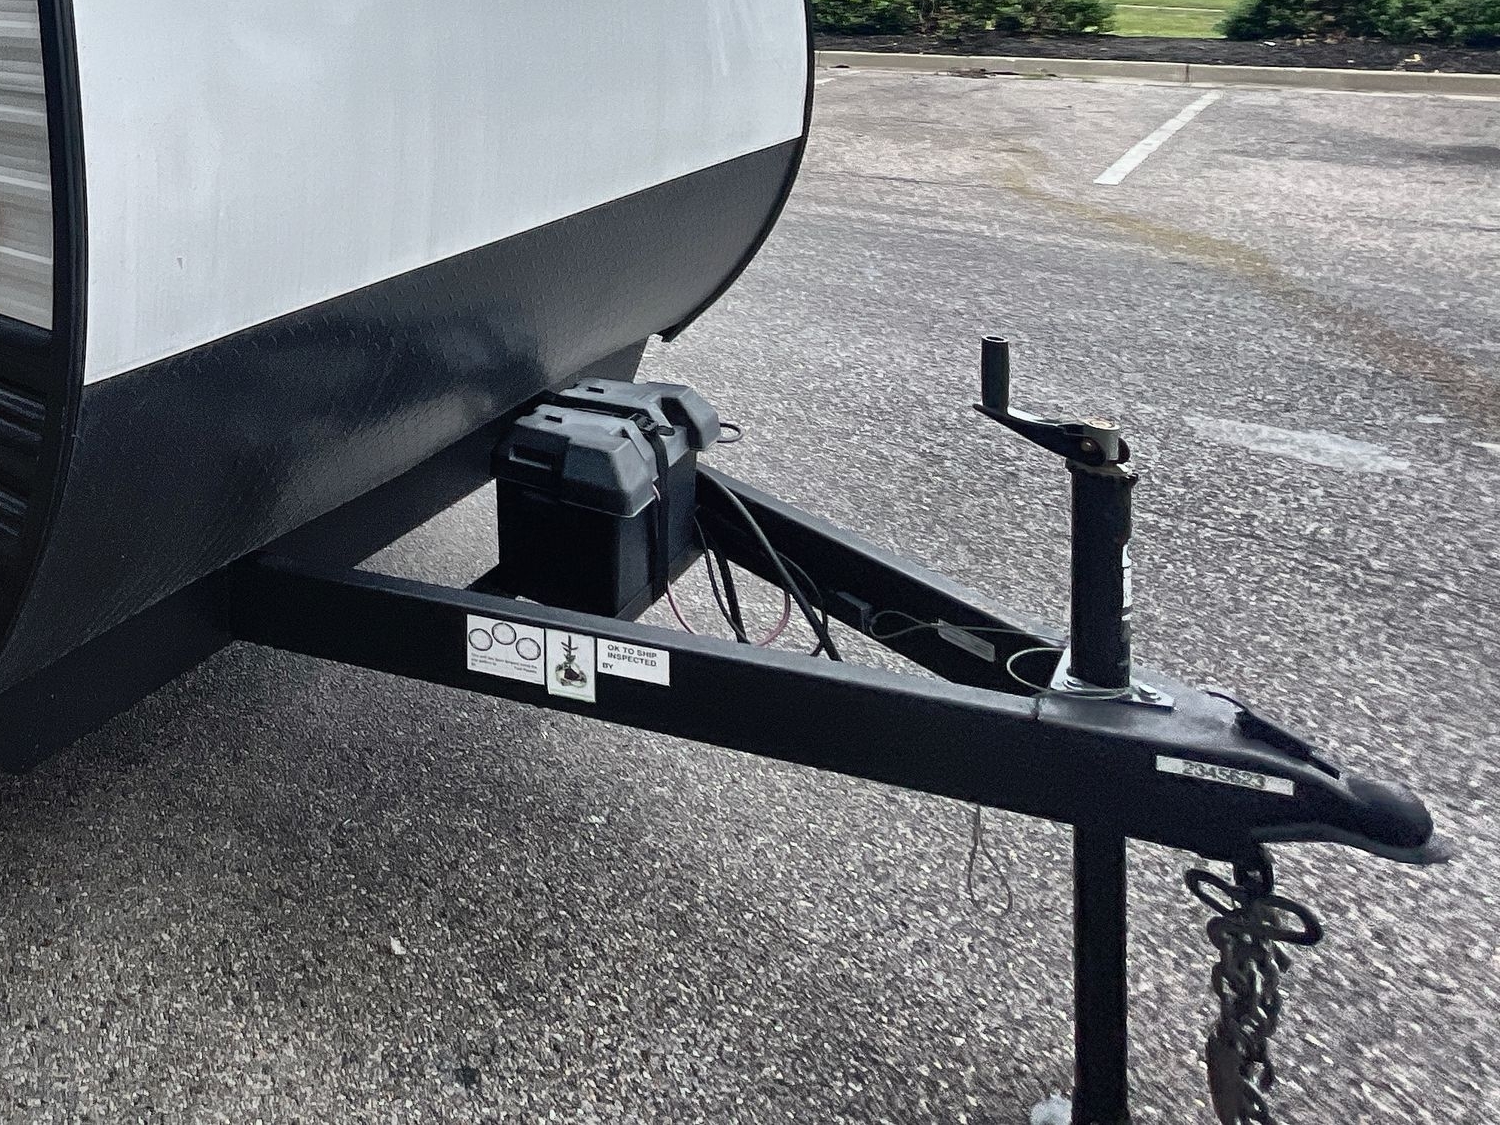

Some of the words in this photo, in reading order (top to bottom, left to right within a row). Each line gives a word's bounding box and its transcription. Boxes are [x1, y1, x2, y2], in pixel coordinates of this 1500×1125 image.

[607, 644, 620, 652] OK
[622, 647, 635, 655] TO
[637, 649, 657, 659] SHIP
[607, 652, 657, 667] INSPECTED
